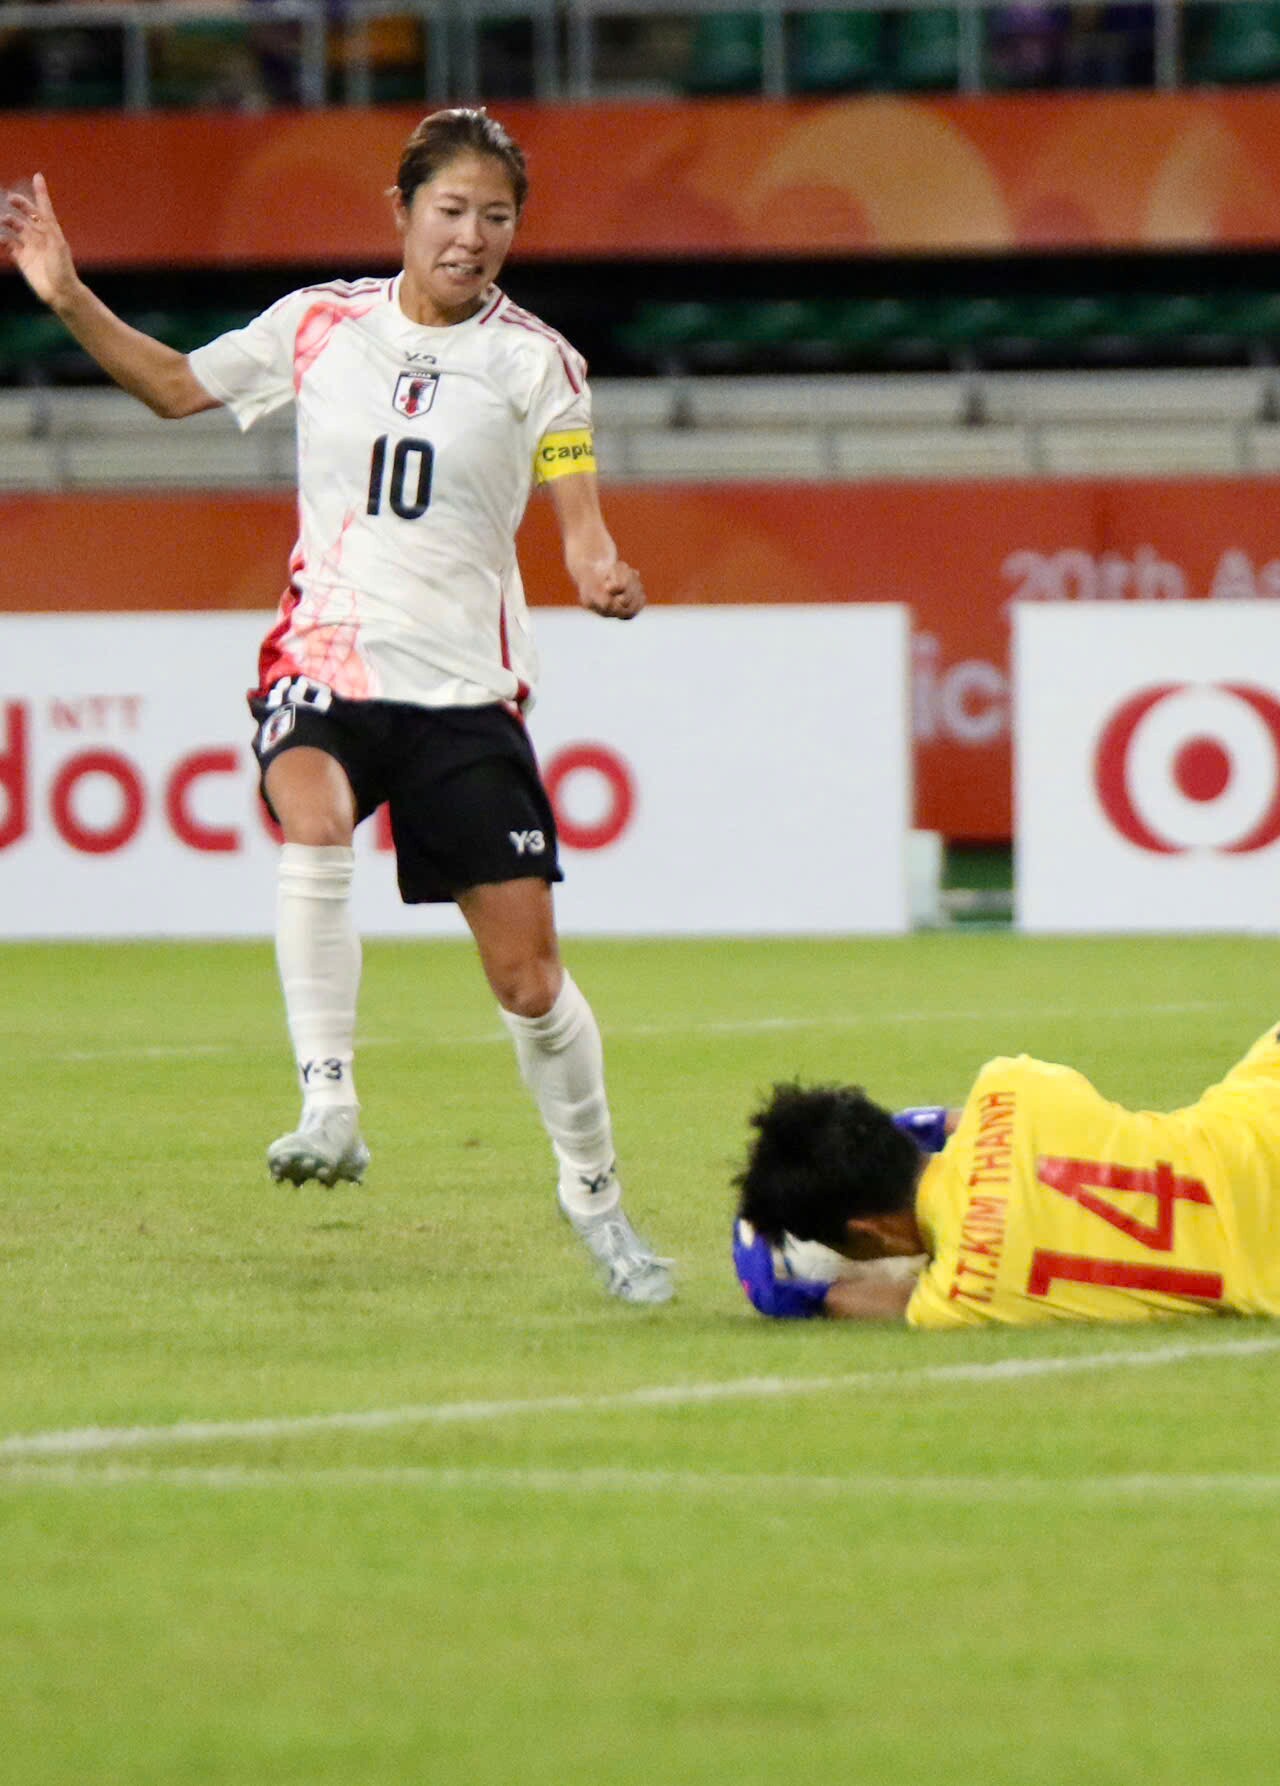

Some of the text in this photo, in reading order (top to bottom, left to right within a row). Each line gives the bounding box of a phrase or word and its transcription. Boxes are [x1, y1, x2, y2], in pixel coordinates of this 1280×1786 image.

[367, 434, 435, 520] 10
[1000, 545, 1187, 601] 20th
[51, 694, 145, 732] NTT
[265, 674, 333, 712] 10
[301, 1057, 343, 1084] Y-3
[948, 1091, 1016, 1304] T.T.KIM THANH
[1026, 1154, 1224, 1301] 14
